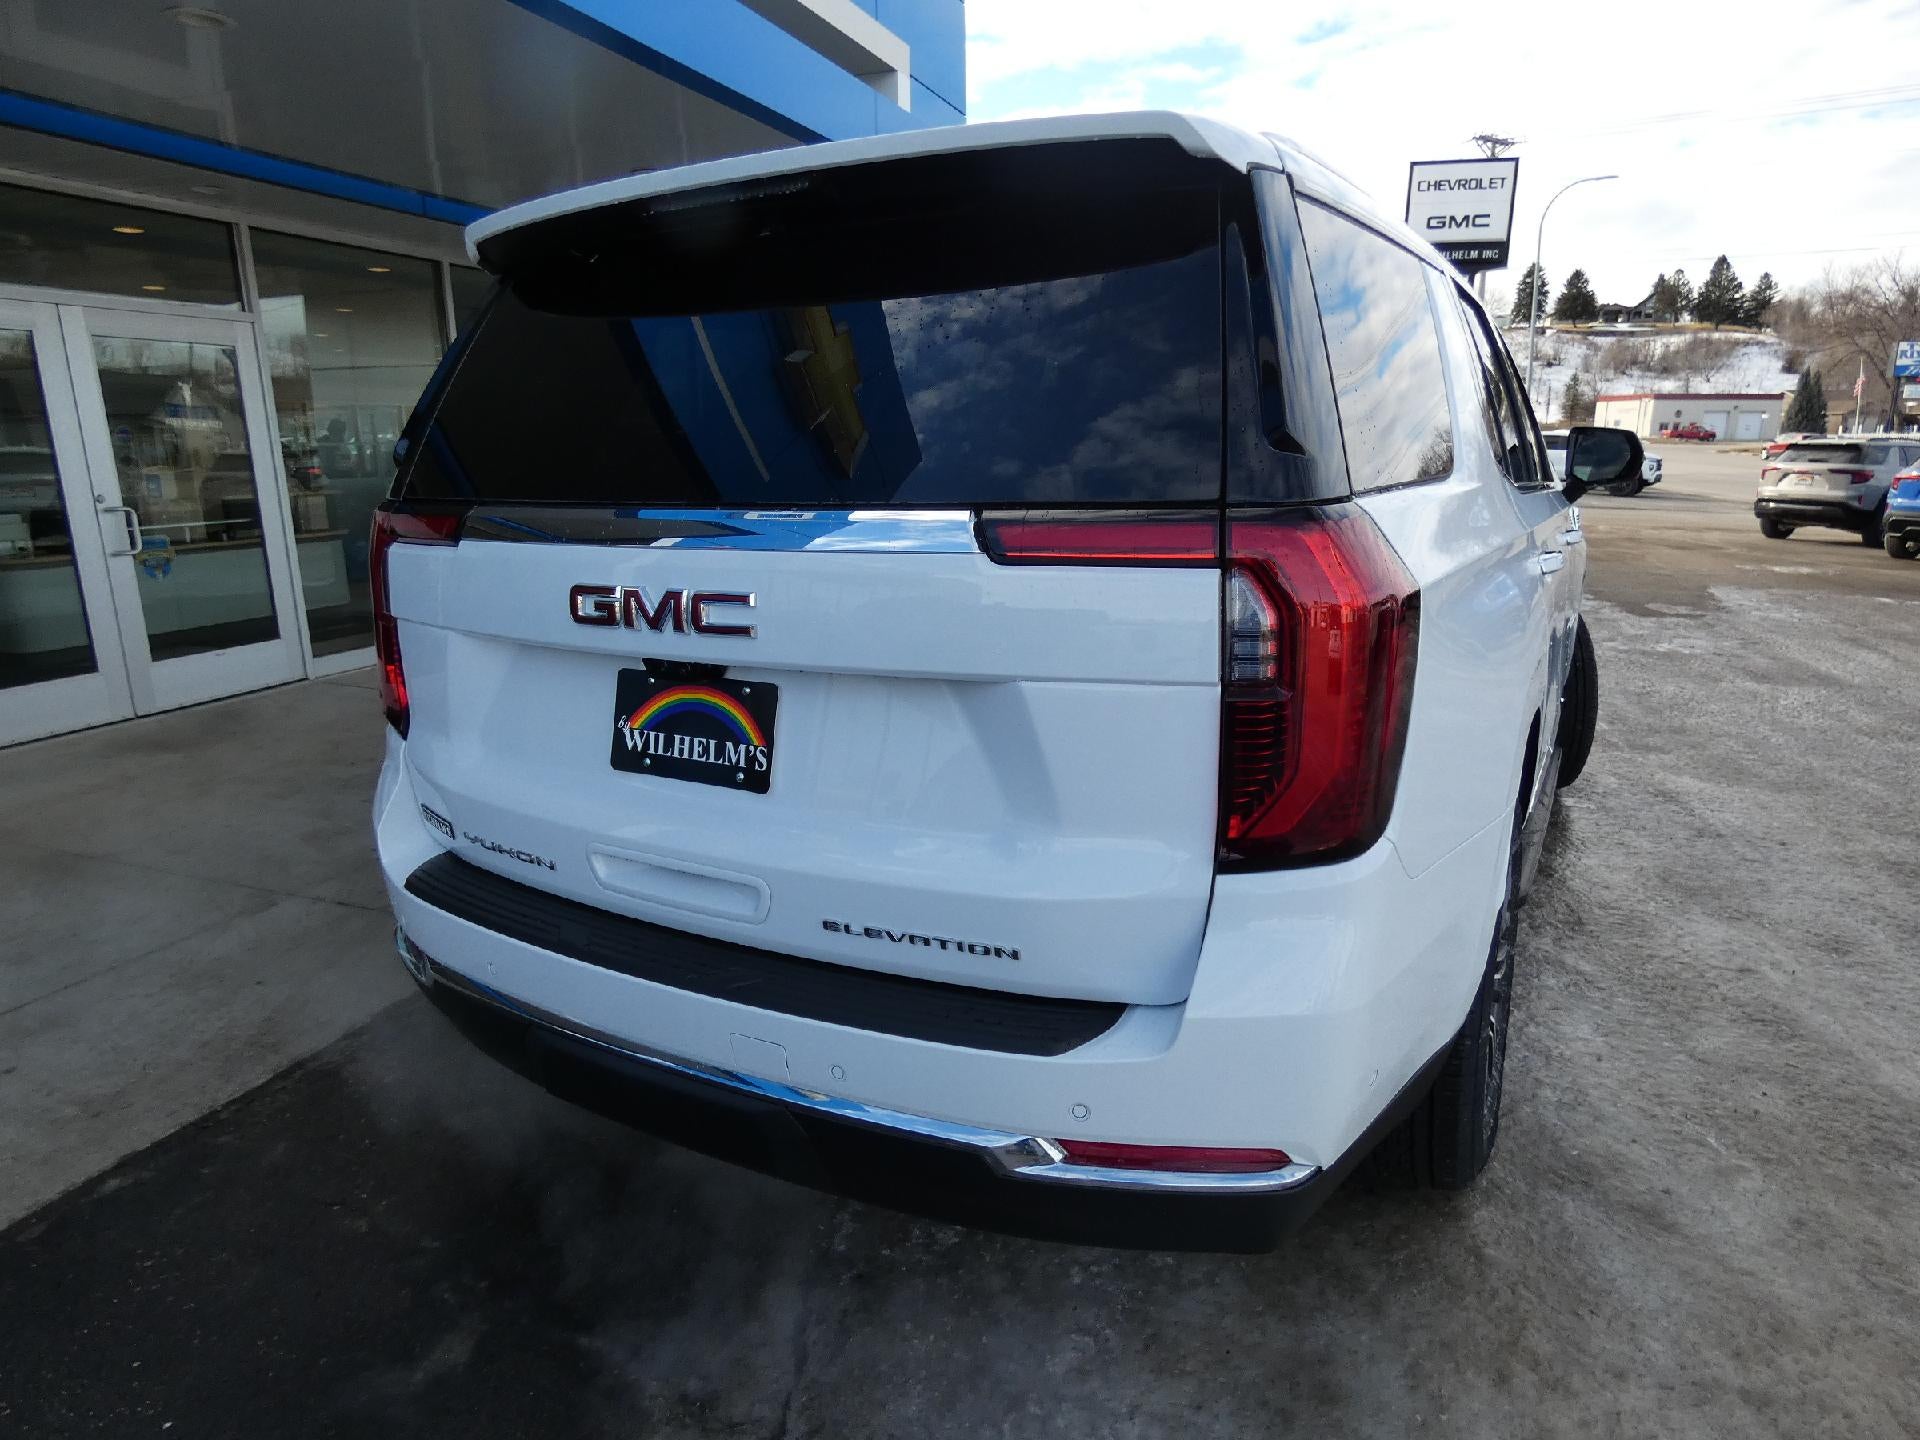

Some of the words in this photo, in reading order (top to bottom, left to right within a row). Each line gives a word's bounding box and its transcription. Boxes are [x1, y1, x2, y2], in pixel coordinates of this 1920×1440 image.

[1417, 177, 1507, 192] CHEVROLET
[1426, 213, 1490, 230] GMC
[1440, 249, 1478, 260] ILHELM
[1482, 249, 1499, 259] INC
[569, 584, 758, 640] GMC
[622, 727, 768, 772] WILHELM'S
[463, 831, 557, 872] YUKON
[821, 918, 1022, 961] ELEVATION
